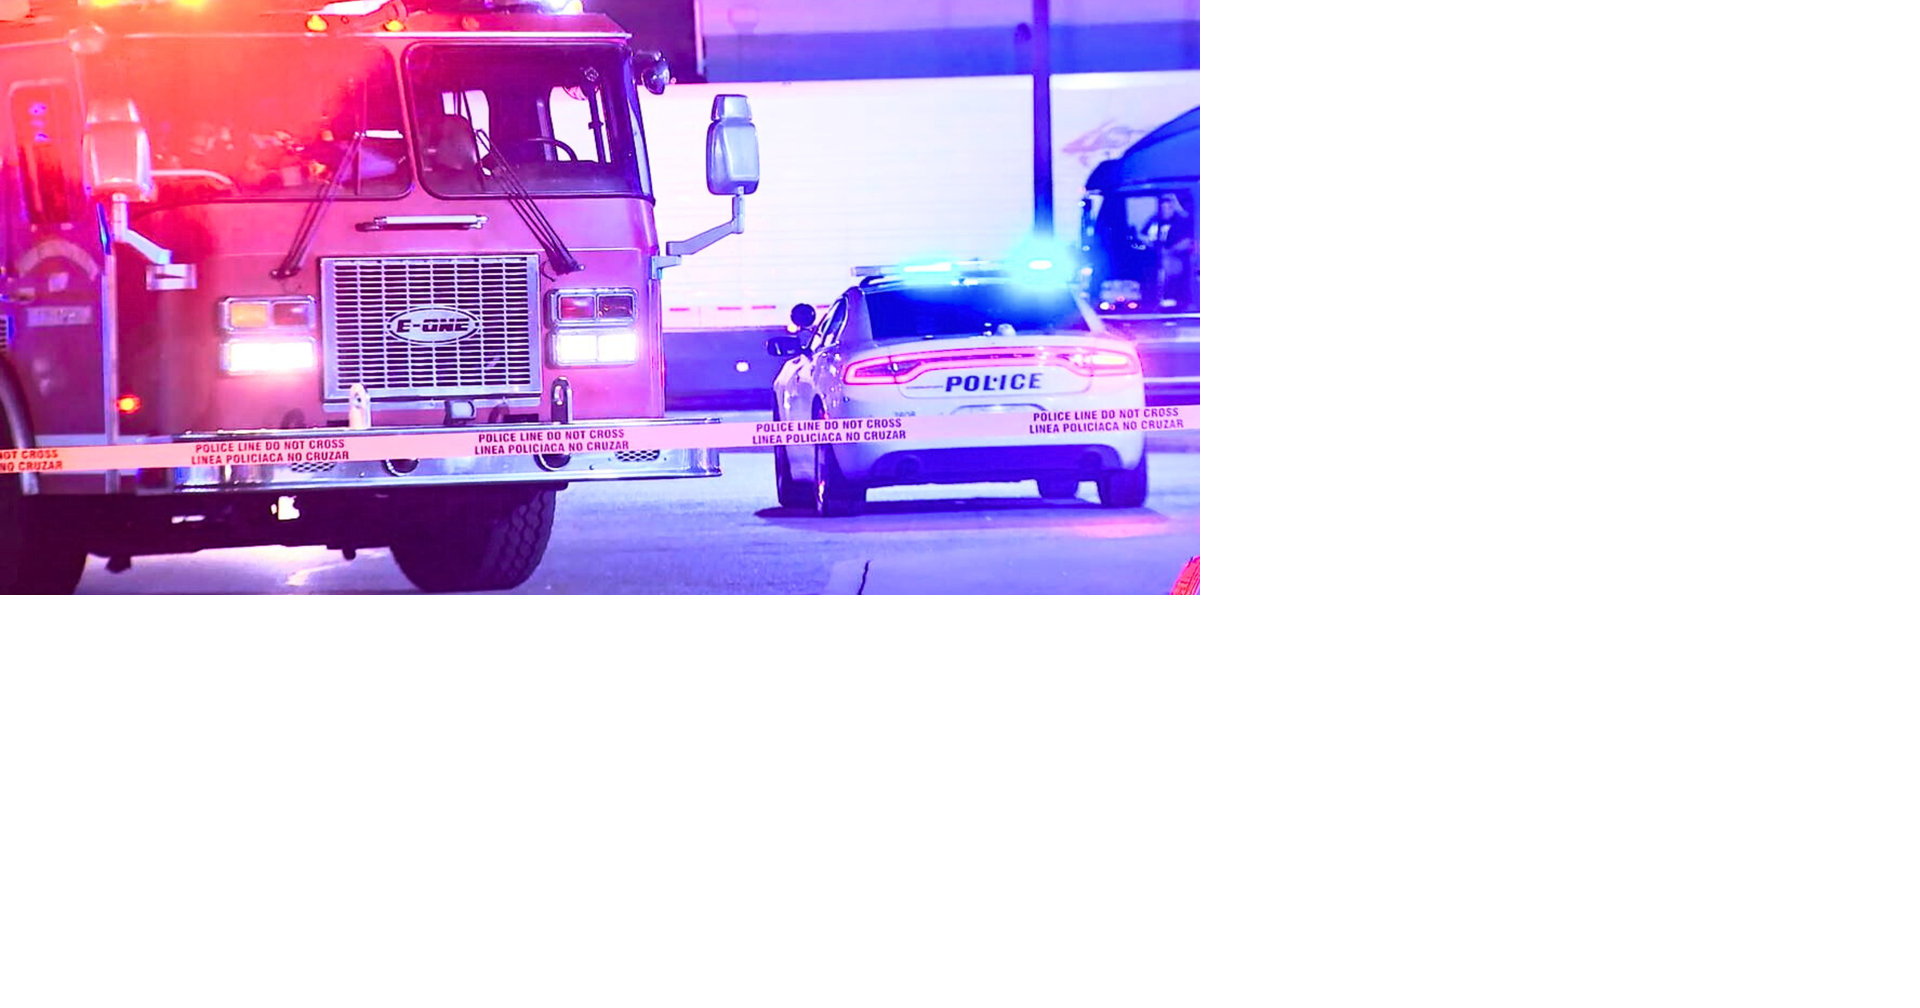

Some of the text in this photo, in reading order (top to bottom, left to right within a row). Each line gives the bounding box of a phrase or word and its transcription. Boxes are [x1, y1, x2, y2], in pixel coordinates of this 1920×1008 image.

[396, 318, 470, 333] E-ONE
[945, 373, 1043, 392] POLICE
[1034, 408, 1179, 422] POLICE LINE DO NOT CROSS
[756, 418, 902, 432] POLICE LINE DO NOT CROSS
[1123, 421, 1137, 430] NO
[1141, 419, 1184, 429] CRUZAR
[478, 429, 625, 443] POLICE LINE DO NOT CROSS
[846, 432, 860, 441] NO
[864, 430, 906, 440] CRUZAR
[196, 439, 345, 453] POLICE LINE DO NOT CROSS
[568, 442, 583, 452] NO
[586, 440, 629, 450] CRUZAR
[21, 449, 58, 459] CROSS
[288, 452, 302, 462] NO
[306, 451, 349, 461] CRUZAR
[18, 460, 63, 470] CRUZAR
